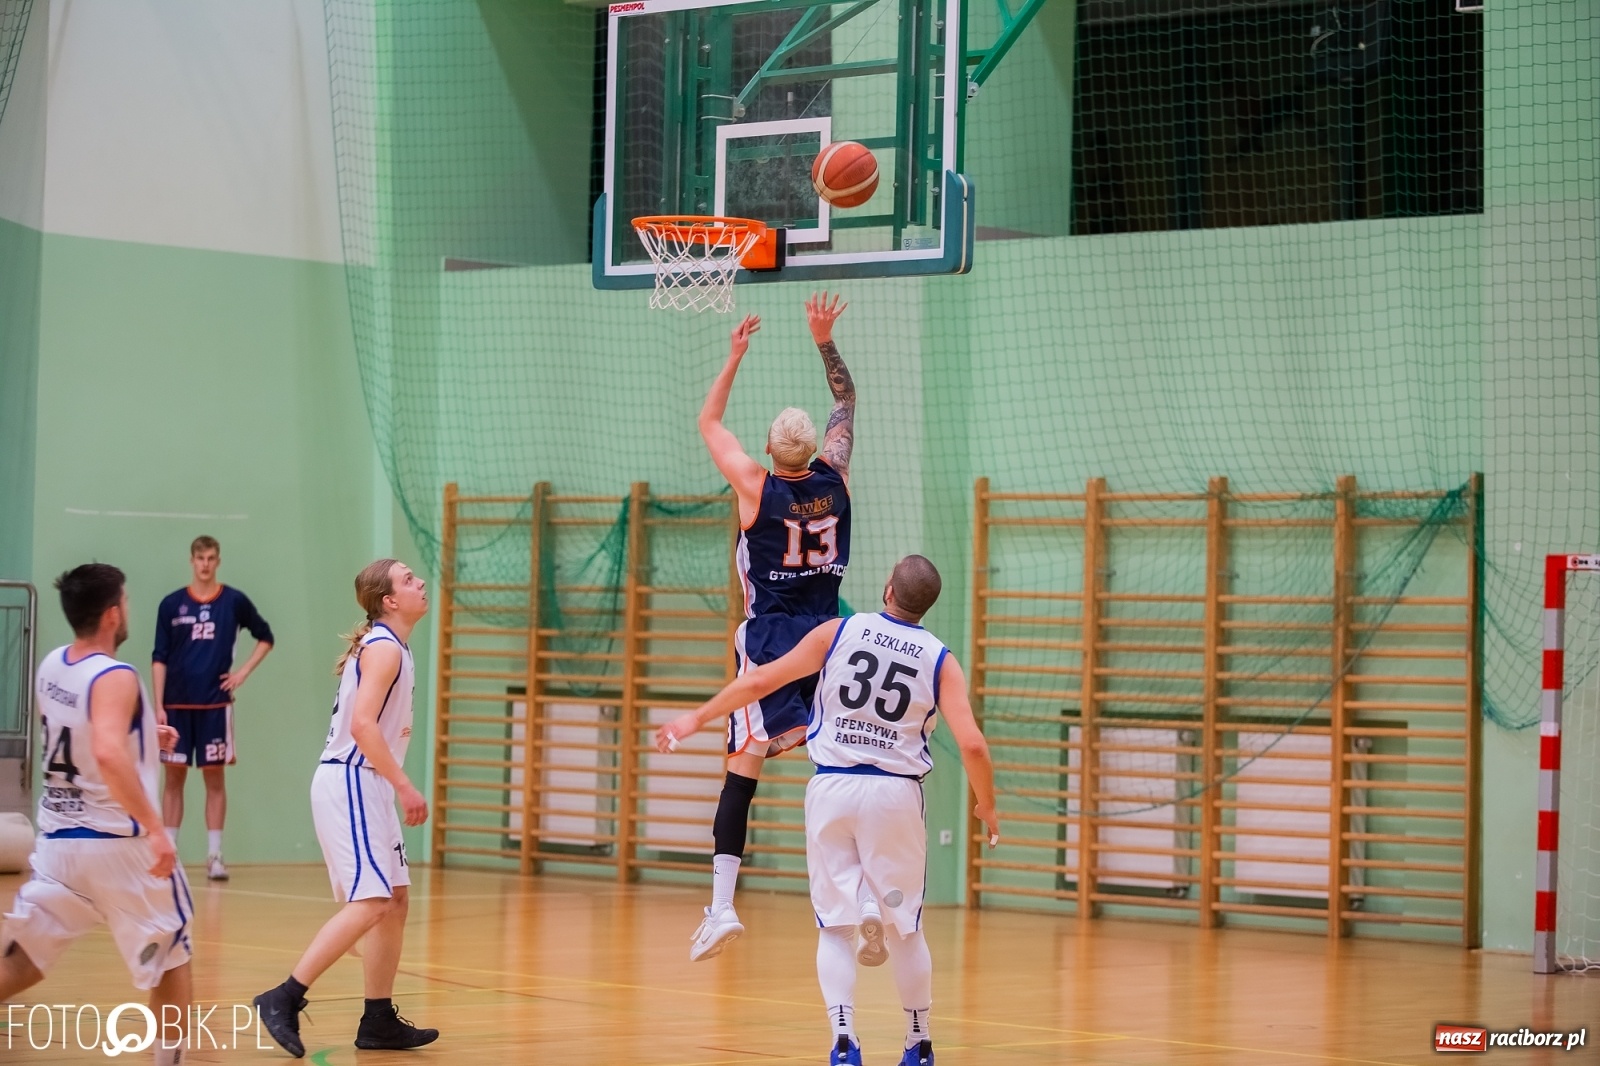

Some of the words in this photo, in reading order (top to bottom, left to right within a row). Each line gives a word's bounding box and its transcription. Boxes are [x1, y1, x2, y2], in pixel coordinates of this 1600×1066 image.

[610, 2, 645, 13] PESMENPOL
[782, 514, 840, 567] 13
[191, 621, 216, 641] 22
[861, 628, 871, 642] P.
[874, 632, 924, 659] SZKLARZ
[838, 650, 919, 723] 35
[835, 716, 899, 741] OFENSYWA
[205, 743, 227, 762] 22
